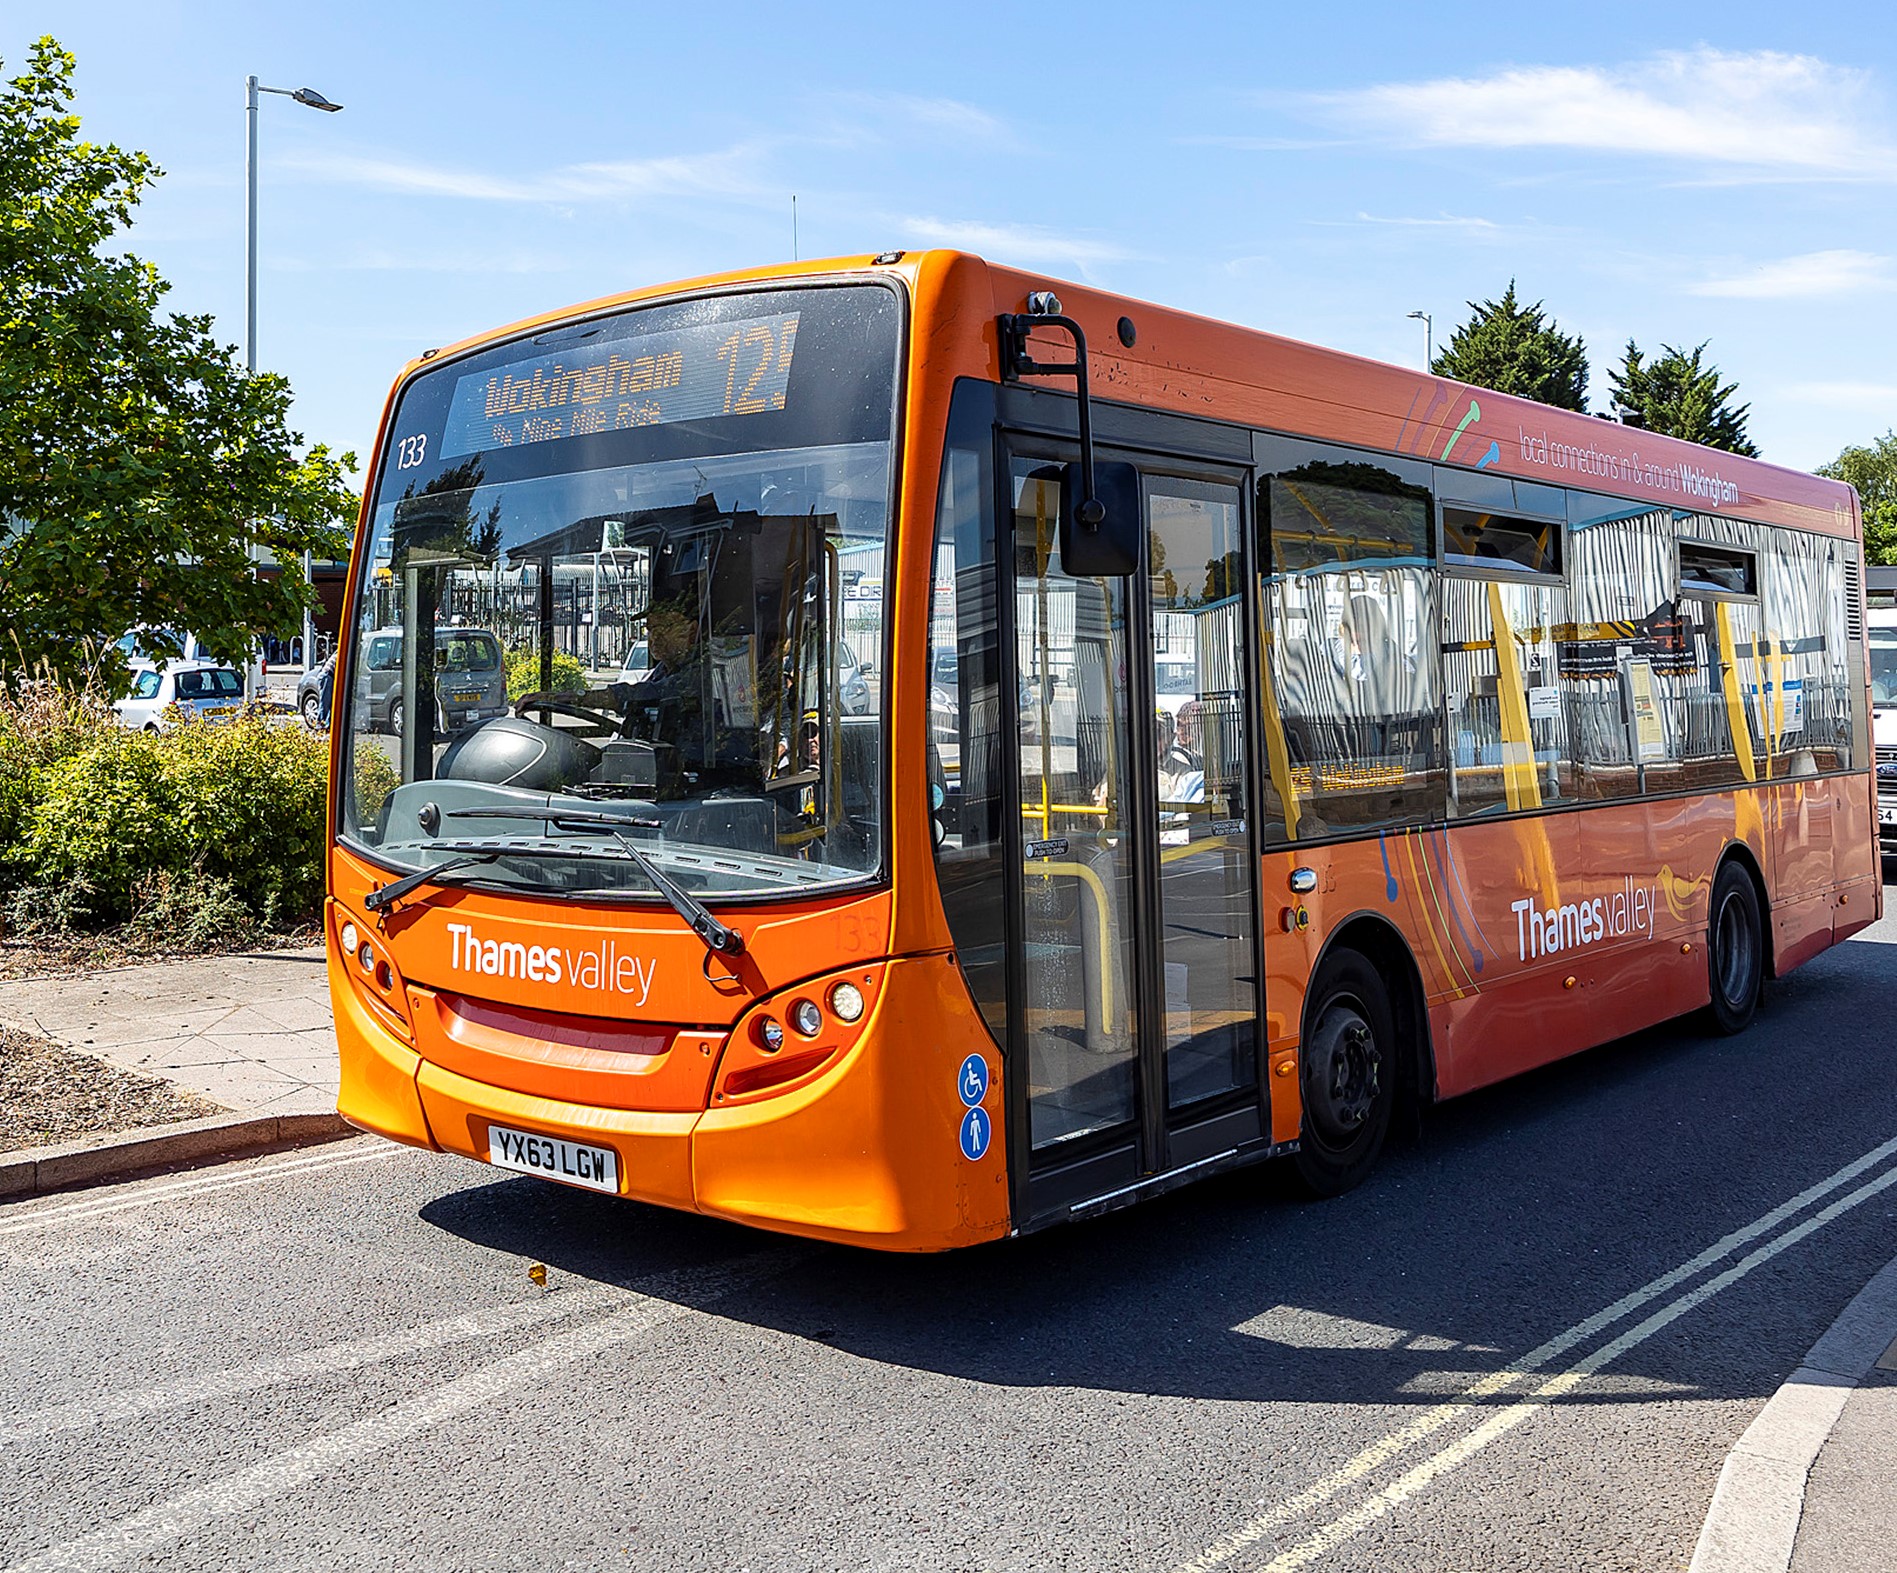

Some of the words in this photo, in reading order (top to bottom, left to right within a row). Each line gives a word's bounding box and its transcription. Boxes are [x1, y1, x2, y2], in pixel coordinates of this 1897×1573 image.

[485, 351, 683, 418] Wokingham
[398, 433, 427, 470] 133
[1518, 424, 1549, 465] local
[1550, 442, 1618, 480] connections
[1618, 448, 1631, 482] in
[1632, 452, 1643, 484] &
[1644, 462, 1680, 493] around
[1680, 463, 1739, 508] Wokingham
[1511, 897, 1604, 961] Thames
[1604, 875, 1656, 940] valley
[447, 923, 562, 984] Thames
[566, 939, 657, 1007] valley
[498, 1131, 556, 1171] YX63
[561, 1144, 605, 1183] LGW
